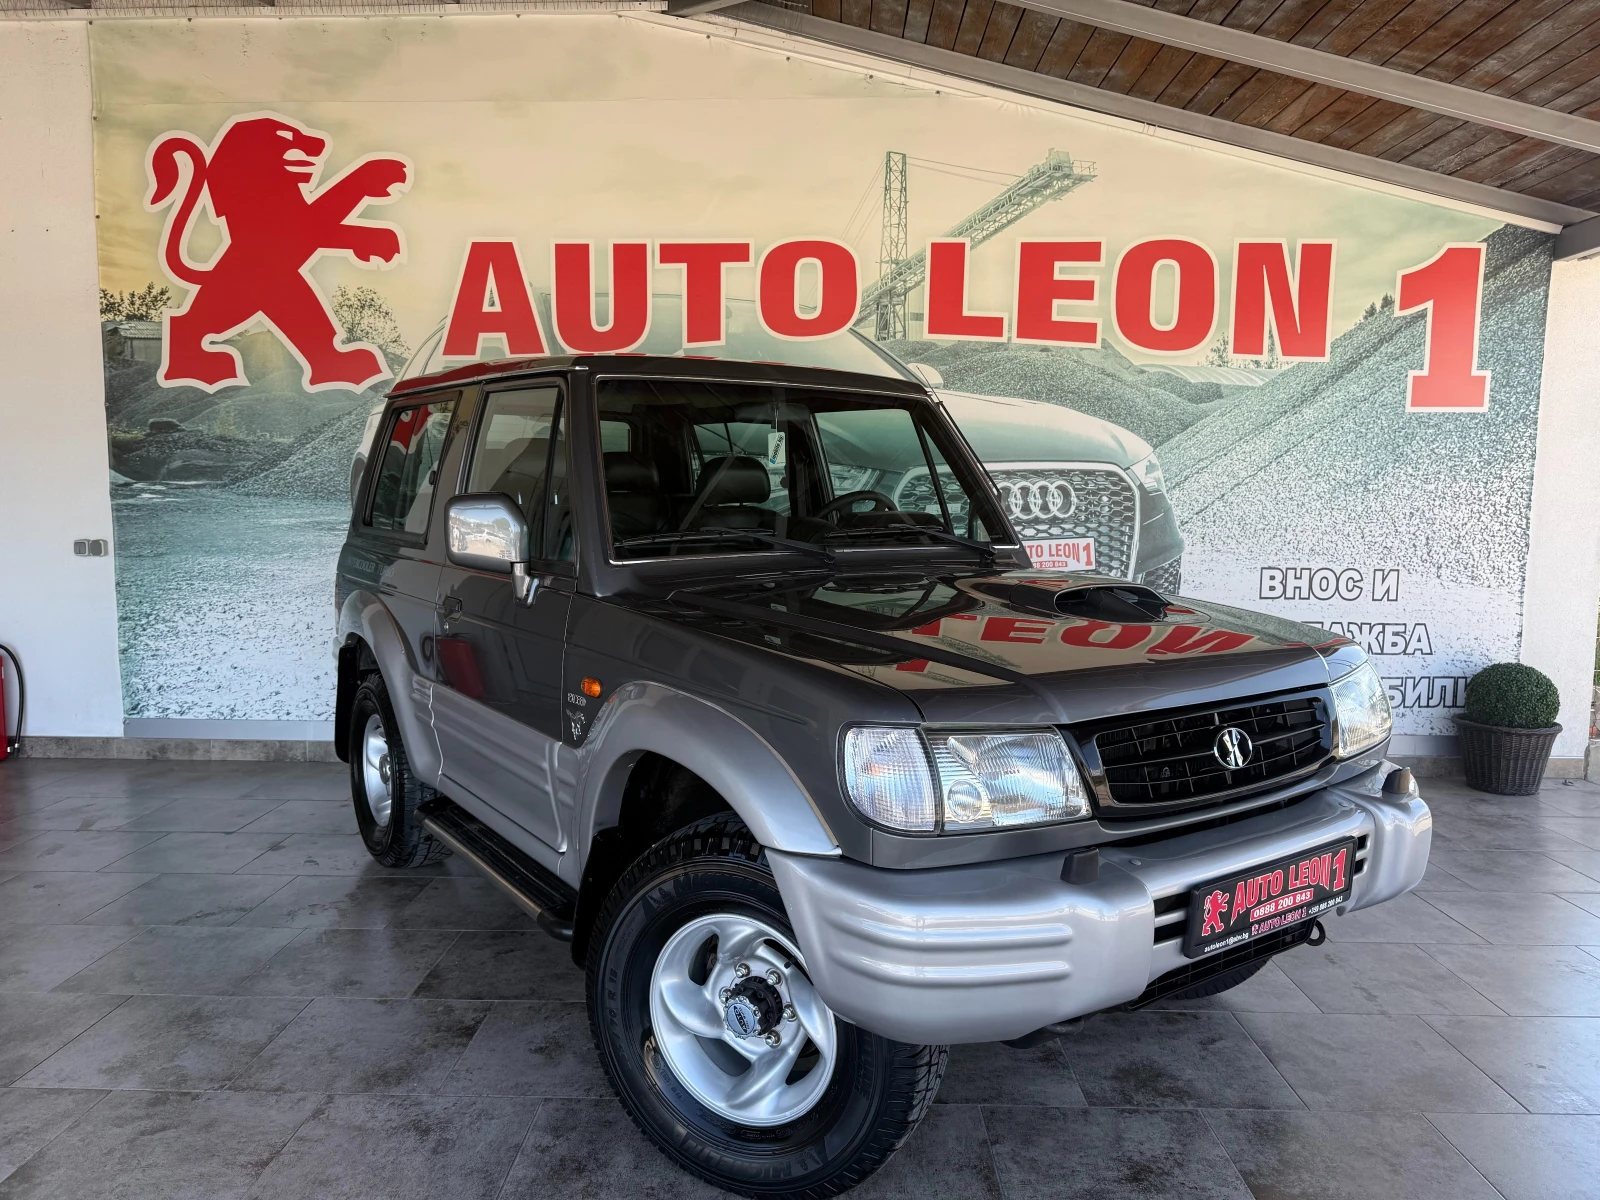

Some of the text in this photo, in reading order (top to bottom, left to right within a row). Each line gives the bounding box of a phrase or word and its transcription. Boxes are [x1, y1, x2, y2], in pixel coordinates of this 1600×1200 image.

[441, 235, 1491, 413] AUTO LEON 1
[1024, 542, 1093, 567] TO LEON 1
[1259, 567, 1400, 601] ВНОС И
[1230, 847, 1347, 927] AUTO LEON 1
[1253, 891, 1312, 918] 0888 200 843
